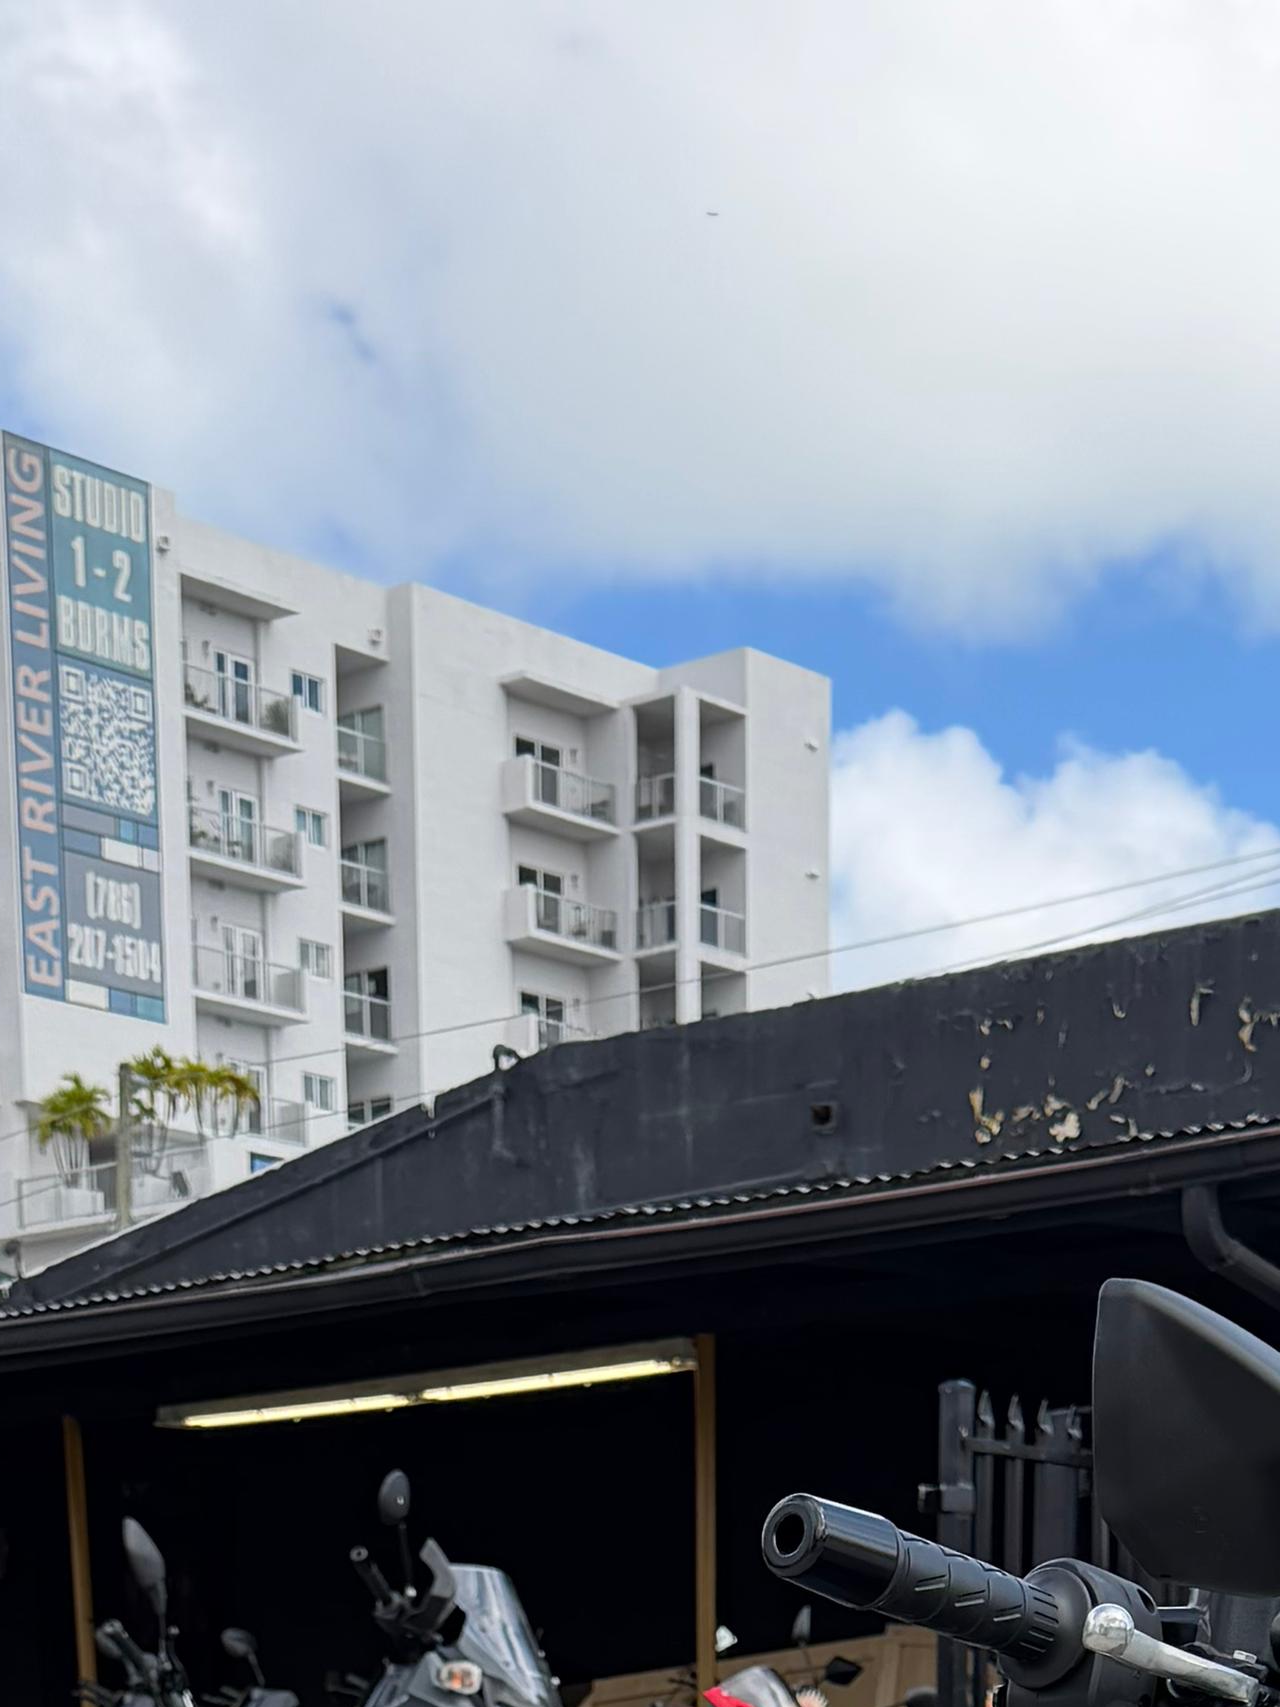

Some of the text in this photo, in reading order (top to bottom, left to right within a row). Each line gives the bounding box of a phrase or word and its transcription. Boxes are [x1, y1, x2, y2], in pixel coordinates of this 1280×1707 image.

[53, 464, 145, 543] STUDIO
[57, 594, 150, 671] BDRMS
[9, 448, 62, 988] EAST RIVER LIVING
